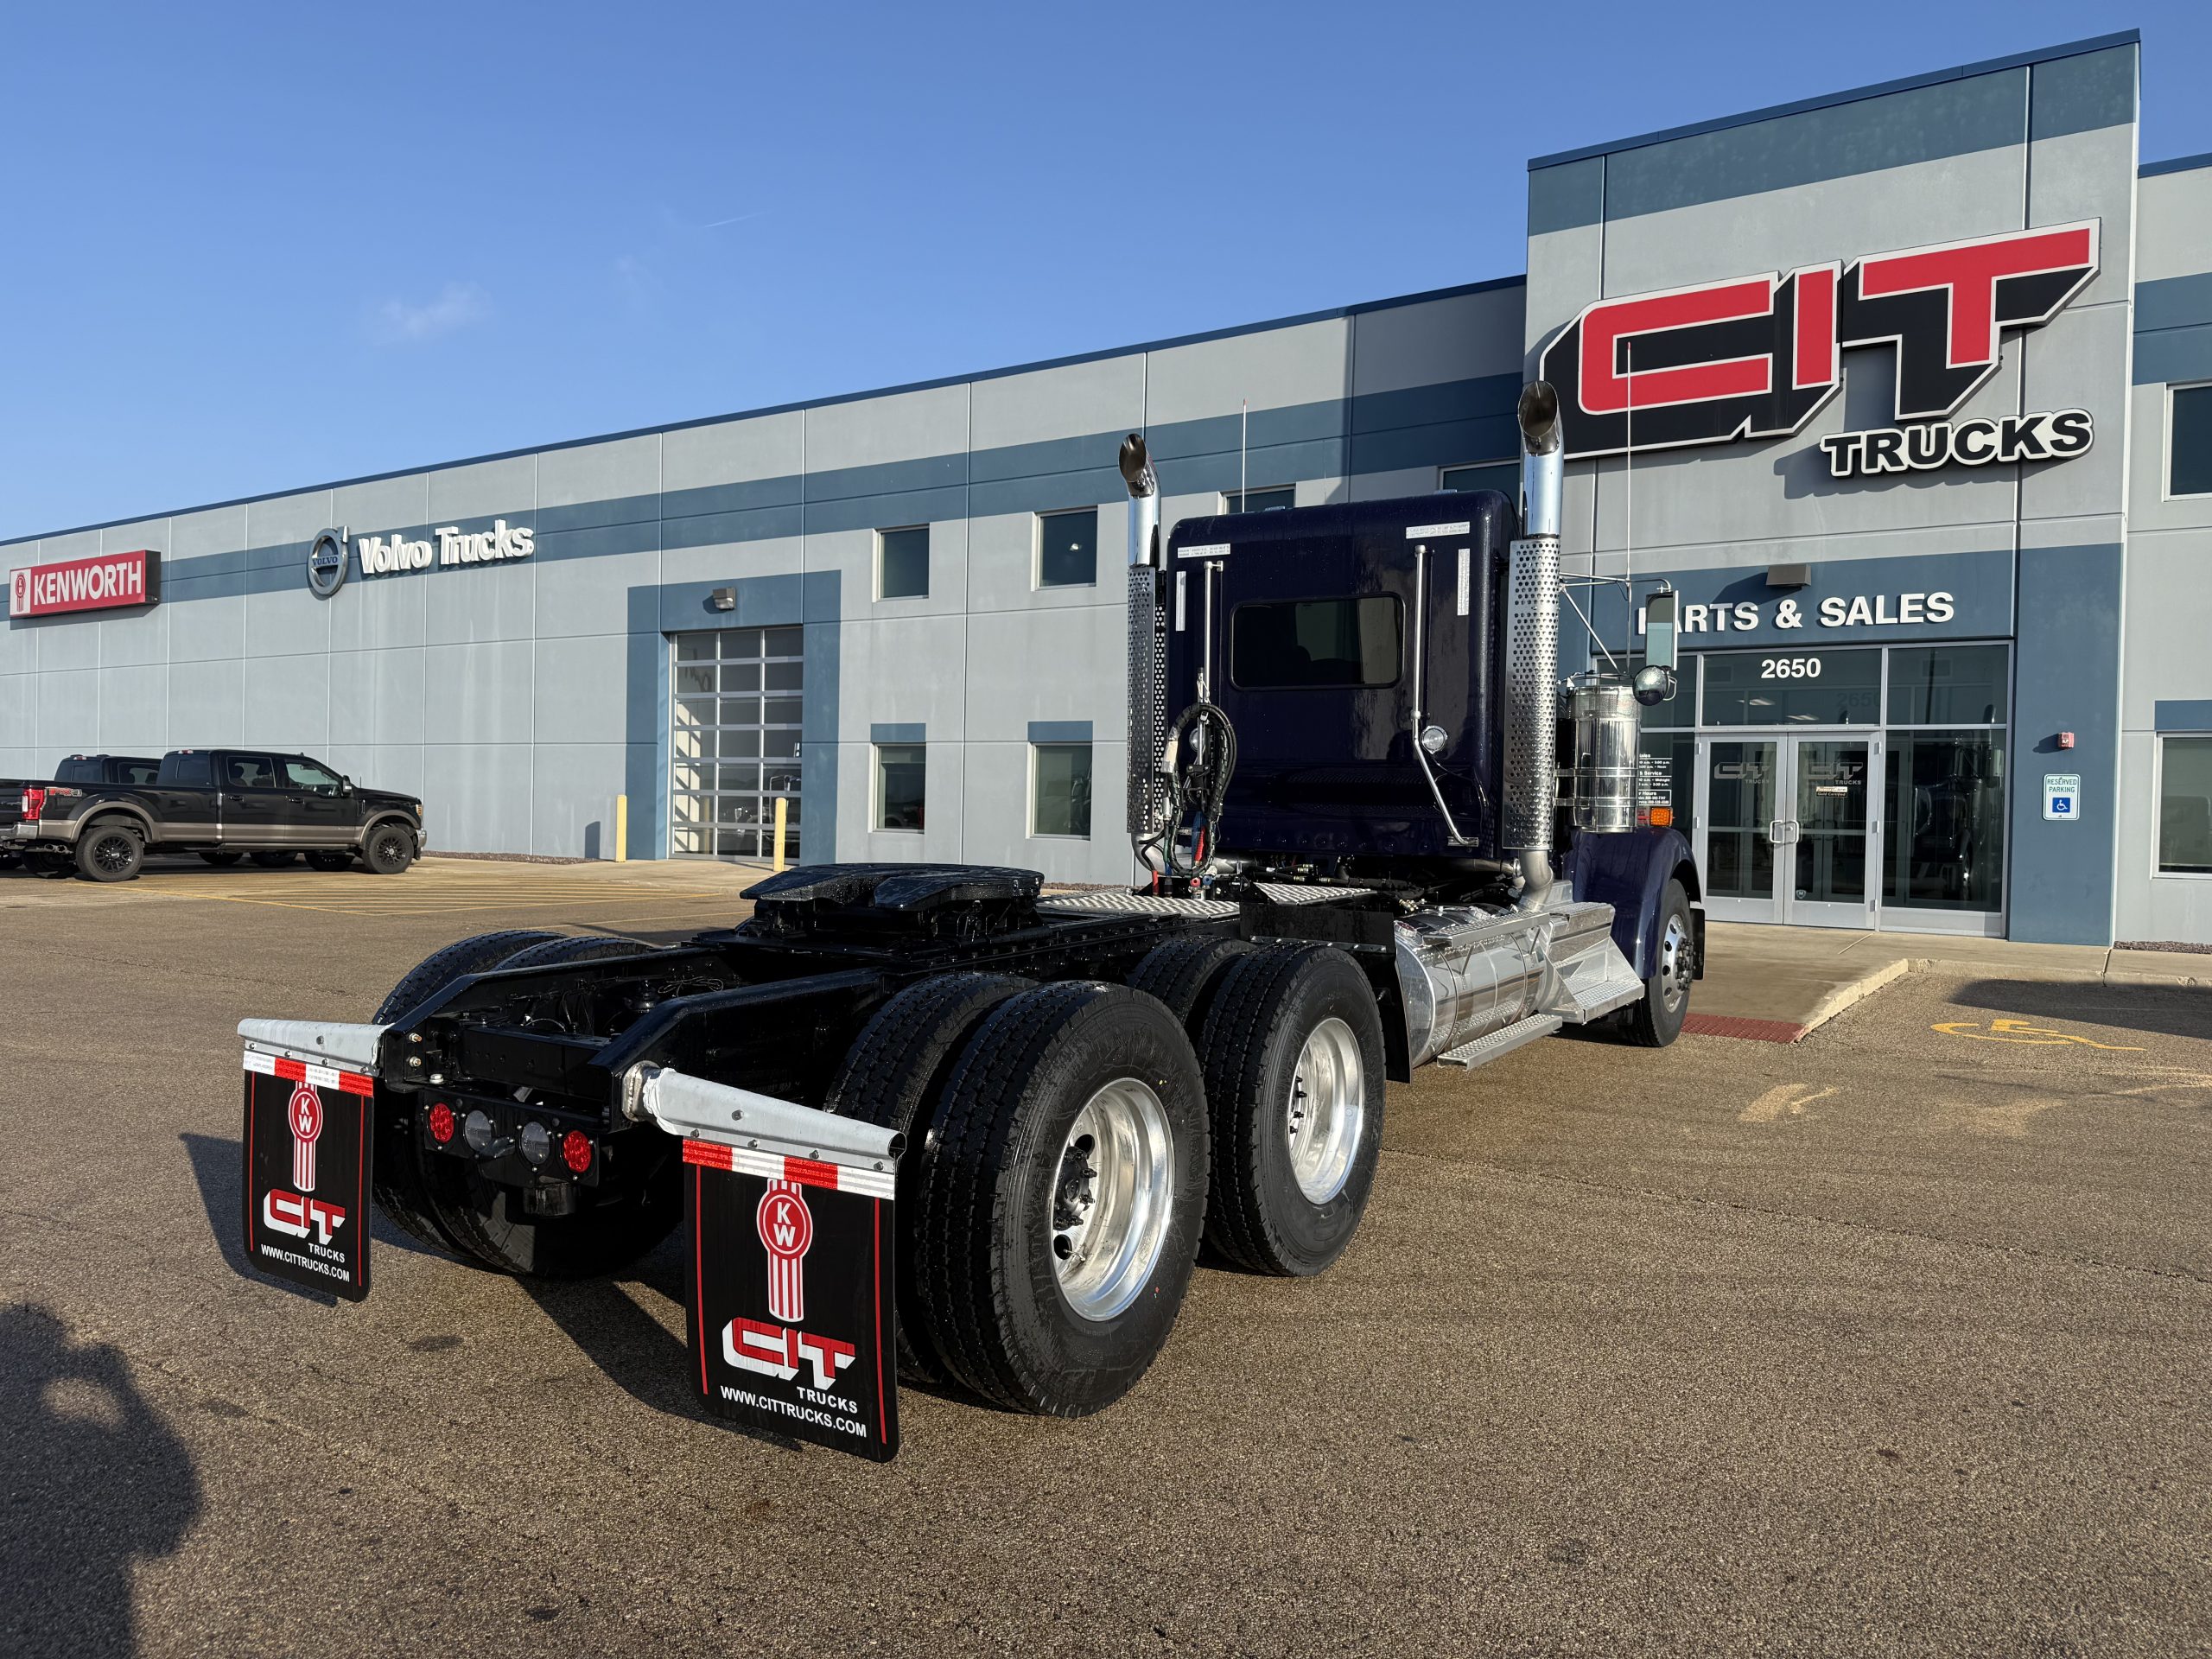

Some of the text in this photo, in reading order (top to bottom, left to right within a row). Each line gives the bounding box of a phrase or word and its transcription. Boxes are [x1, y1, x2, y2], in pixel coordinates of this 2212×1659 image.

[1539, 217, 2101, 459] CIT
[1820, 408, 2094, 478] TRUCKS
[312, 556, 339, 566] VOLVO
[359, 518, 534, 574] Volvo Trucks
[34, 560, 142, 606] KENWORTH
[1775, 599, 1803, 630] &
[1820, 592, 1955, 627] SALES
[1760, 658, 1821, 679] 2650
[264, 1188, 346, 1245] CIT
[260, 1243, 350, 1282] WWW.CITTRUCKS.COM
[308, 1243, 346, 1263] TRUCKS
[722, 1317, 855, 1390] CIT
[720, 1385, 868, 1438] WWW.CITTRUCKS.COM
[796, 1386, 859, 1414] TRUCKS
